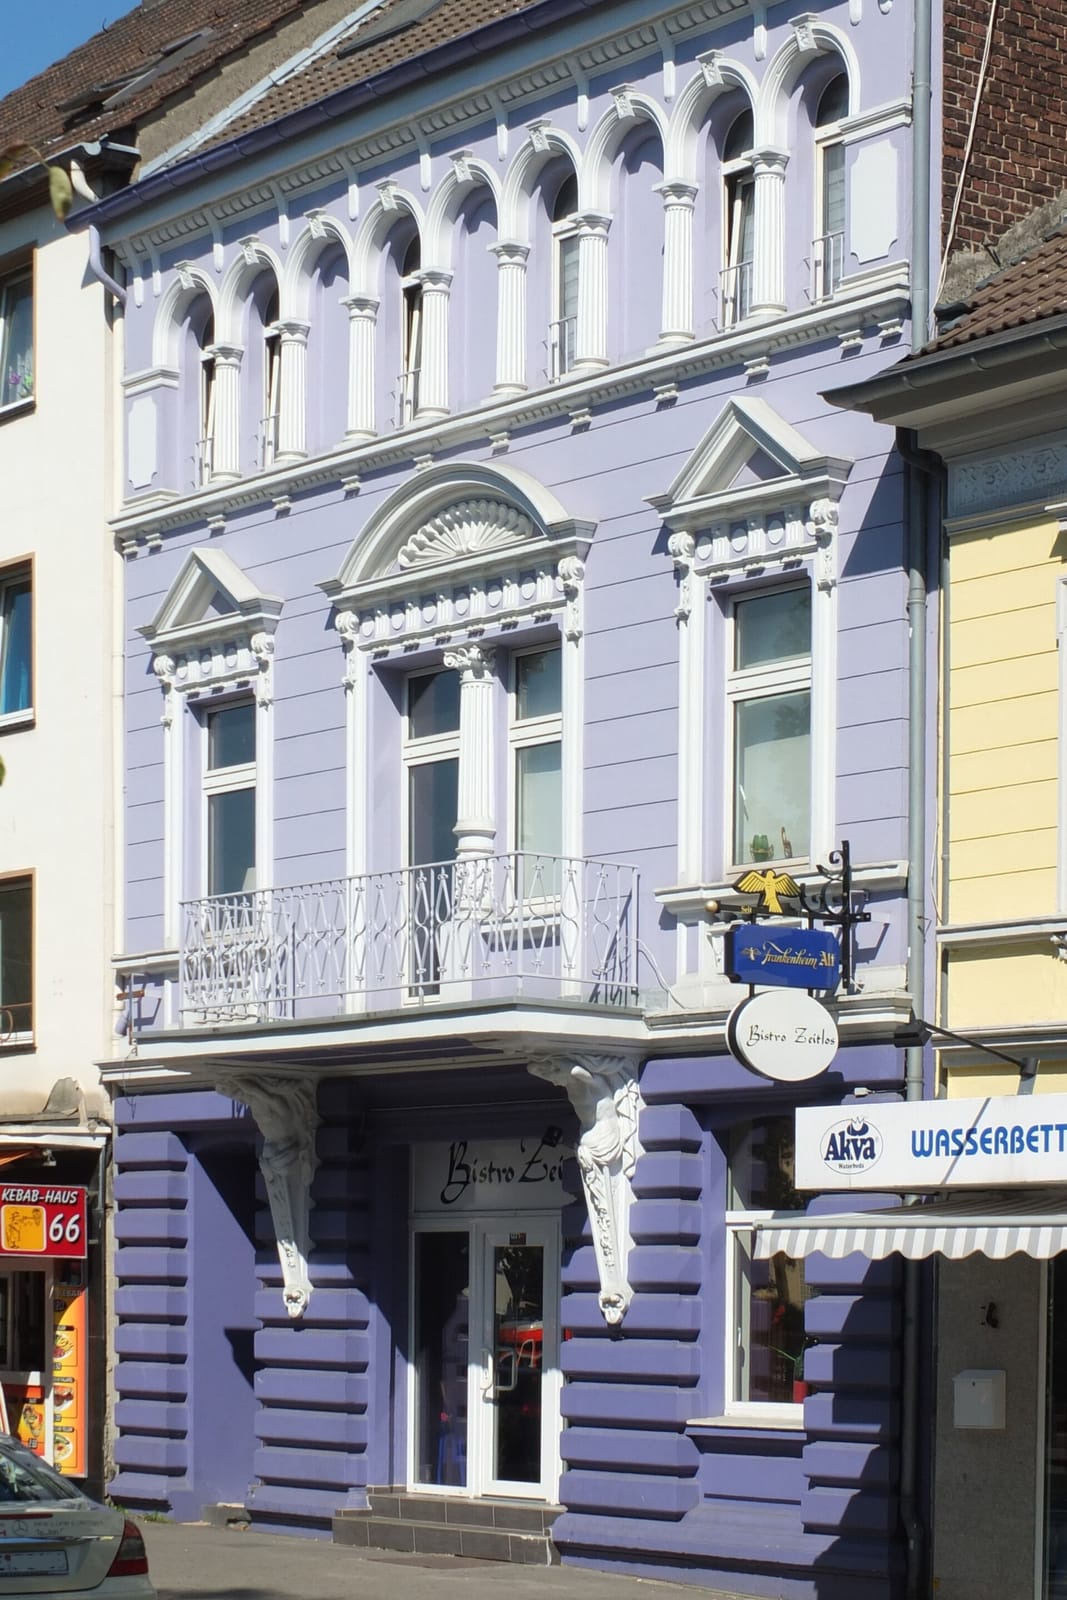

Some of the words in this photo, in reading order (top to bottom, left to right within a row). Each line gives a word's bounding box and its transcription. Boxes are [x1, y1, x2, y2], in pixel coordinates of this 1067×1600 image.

[761, 941, 817, 969] Frankenheim
[818, 950, 835, 967] Alt
[746, 1024, 787, 1047] Bistro
[795, 1027, 835, 1046] Zeitlos
[824, 1130, 876, 1161] Akva
[911, 1123, 1067, 1158] WASSERBETT
[440, 1141, 515, 1204] Bistro
[2, 1188, 78, 1204] KEBAB-HAUS
[49, 1213, 80, 1242] 66
